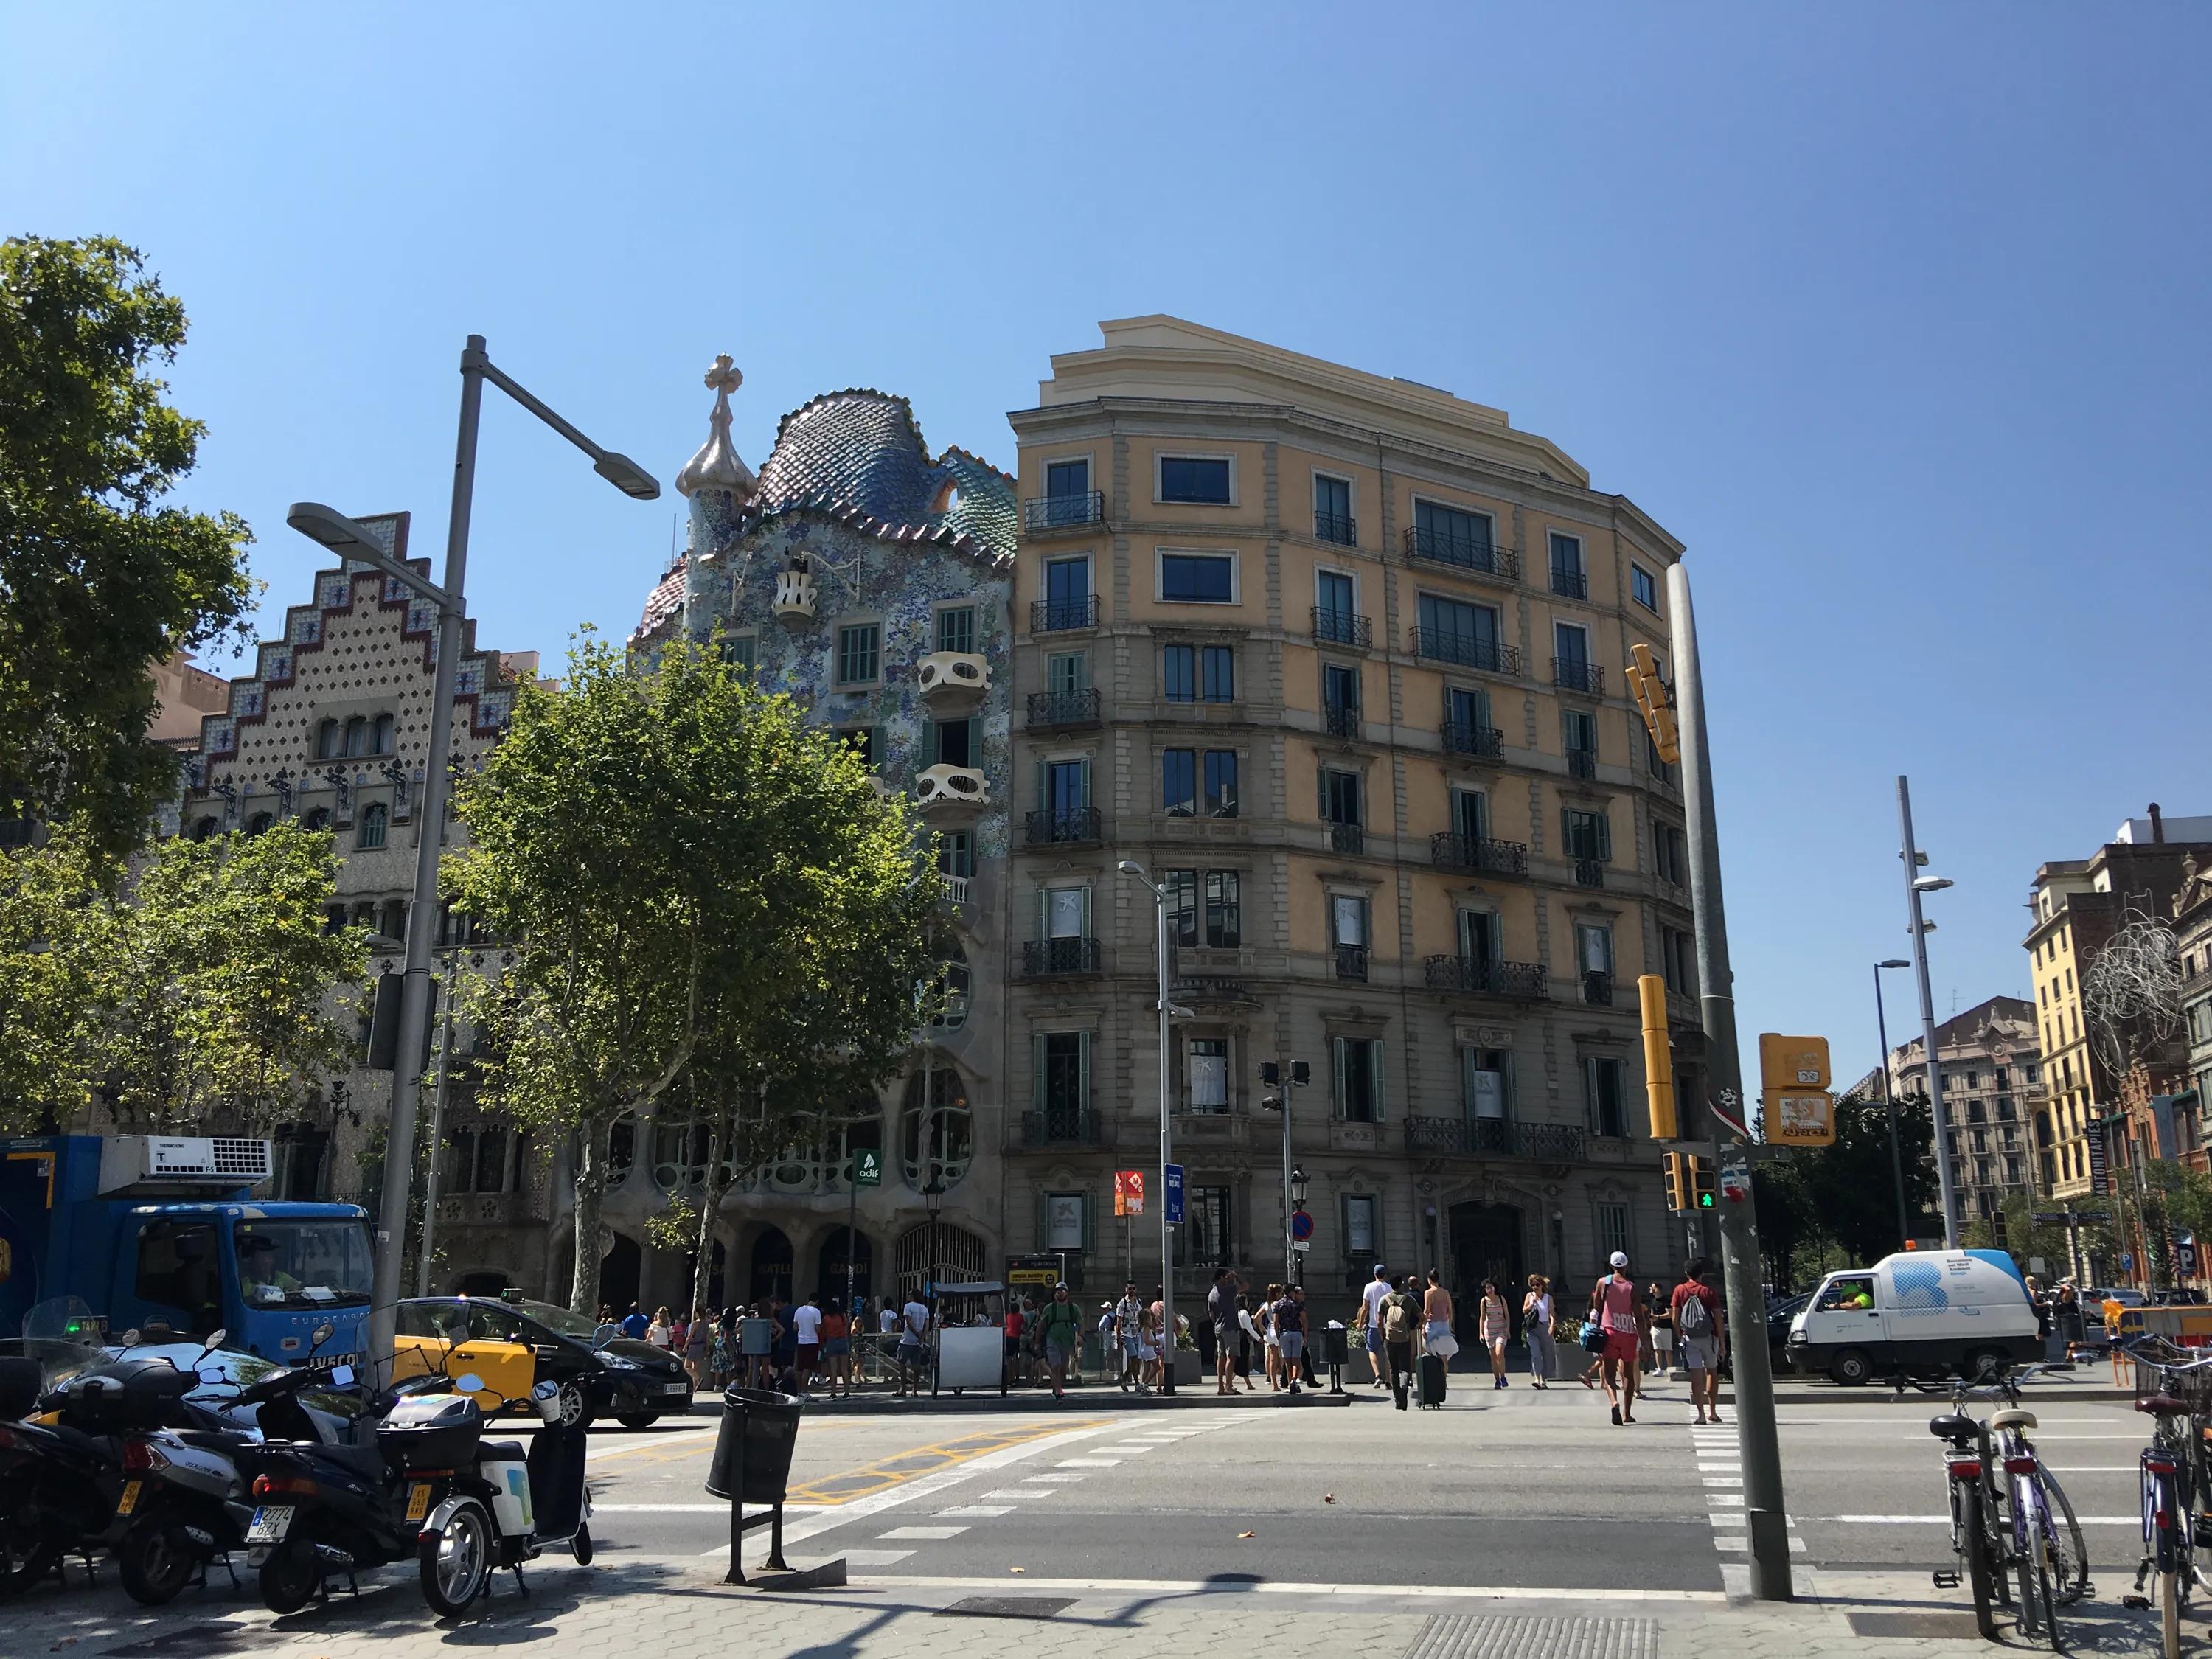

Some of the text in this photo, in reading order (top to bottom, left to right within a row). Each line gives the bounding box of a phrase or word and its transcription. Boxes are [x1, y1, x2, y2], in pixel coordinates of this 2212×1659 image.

[859, 1169, 879, 1178] adif
[2122, 1254, 2130, 1263] P
[2180, 1249, 2194, 1268] P
[262, 1507, 291, 1521] 2774
[257, 1522, 281, 1537] BZX
